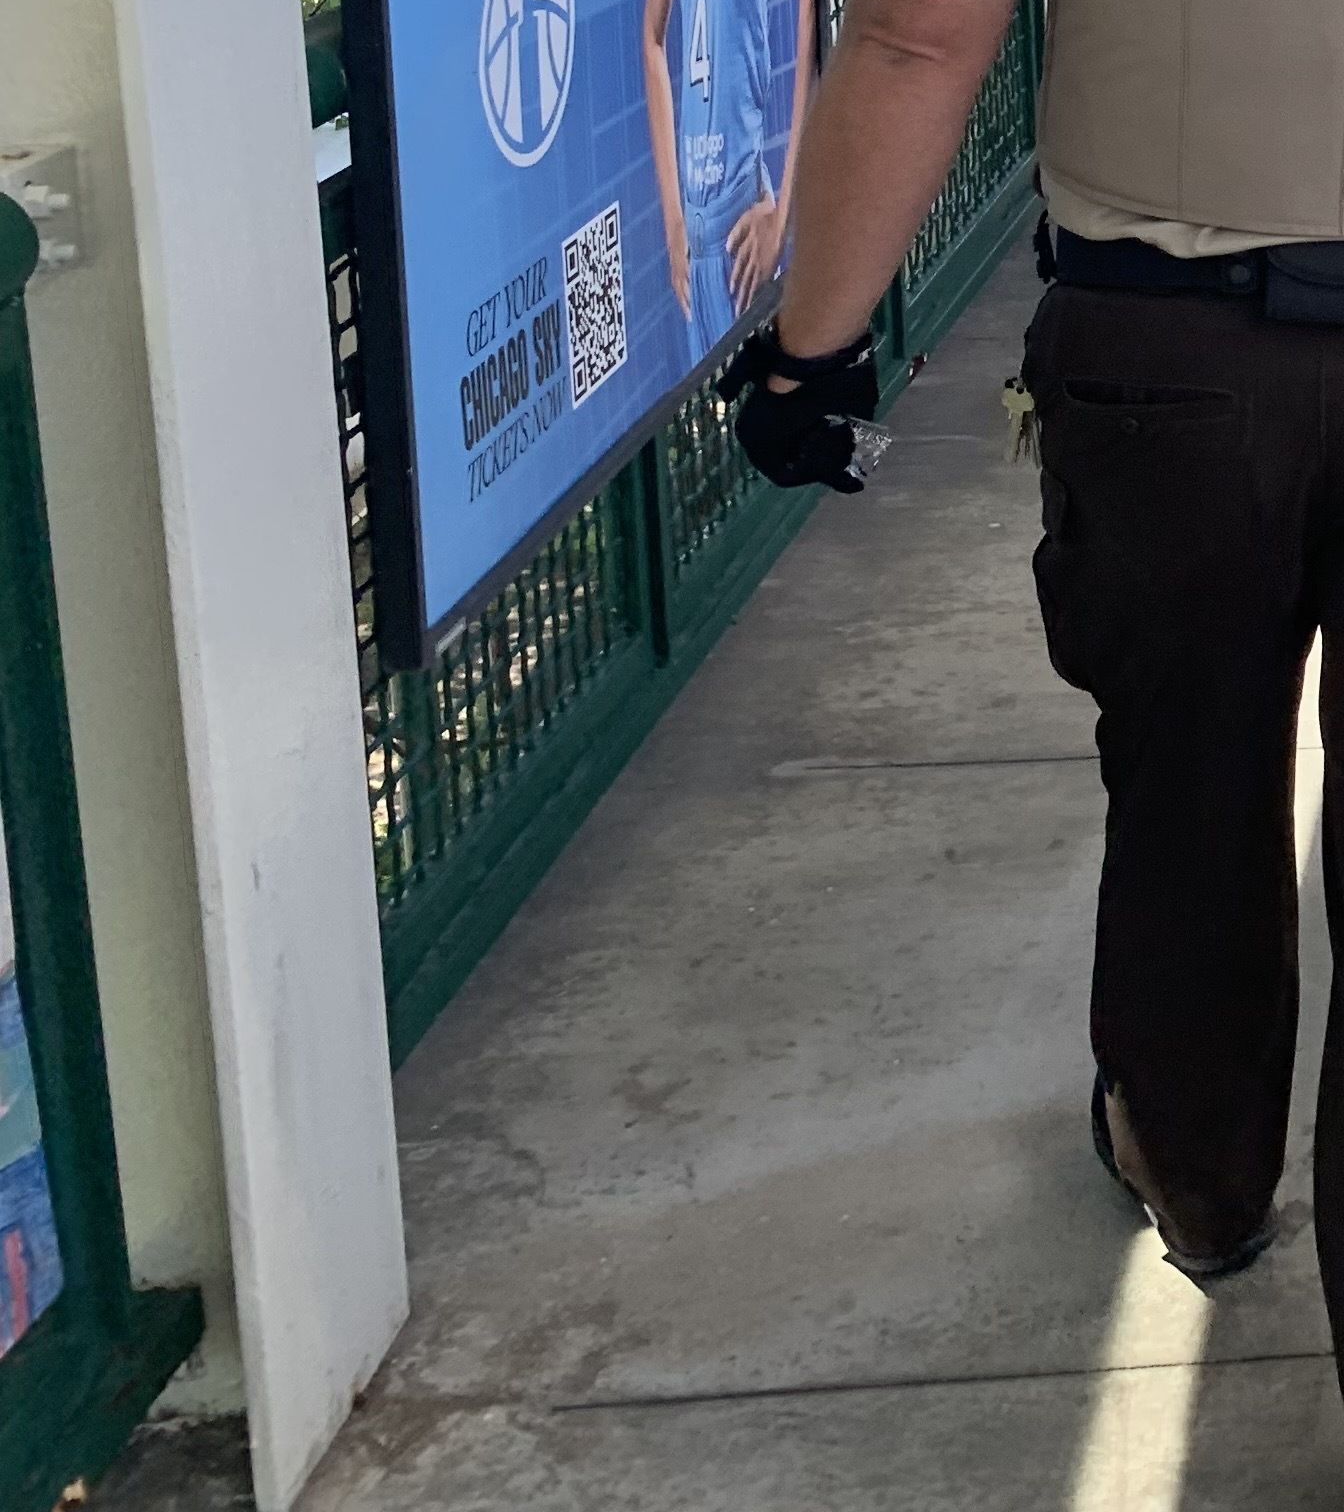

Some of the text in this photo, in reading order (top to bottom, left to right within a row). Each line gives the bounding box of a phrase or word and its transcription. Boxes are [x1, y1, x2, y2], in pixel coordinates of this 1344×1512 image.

[466, 256, 548, 357] GET YOUR
[460, 299, 562, 451] CHICAGO SKY
[468, 412, 530, 504] TICKETS
